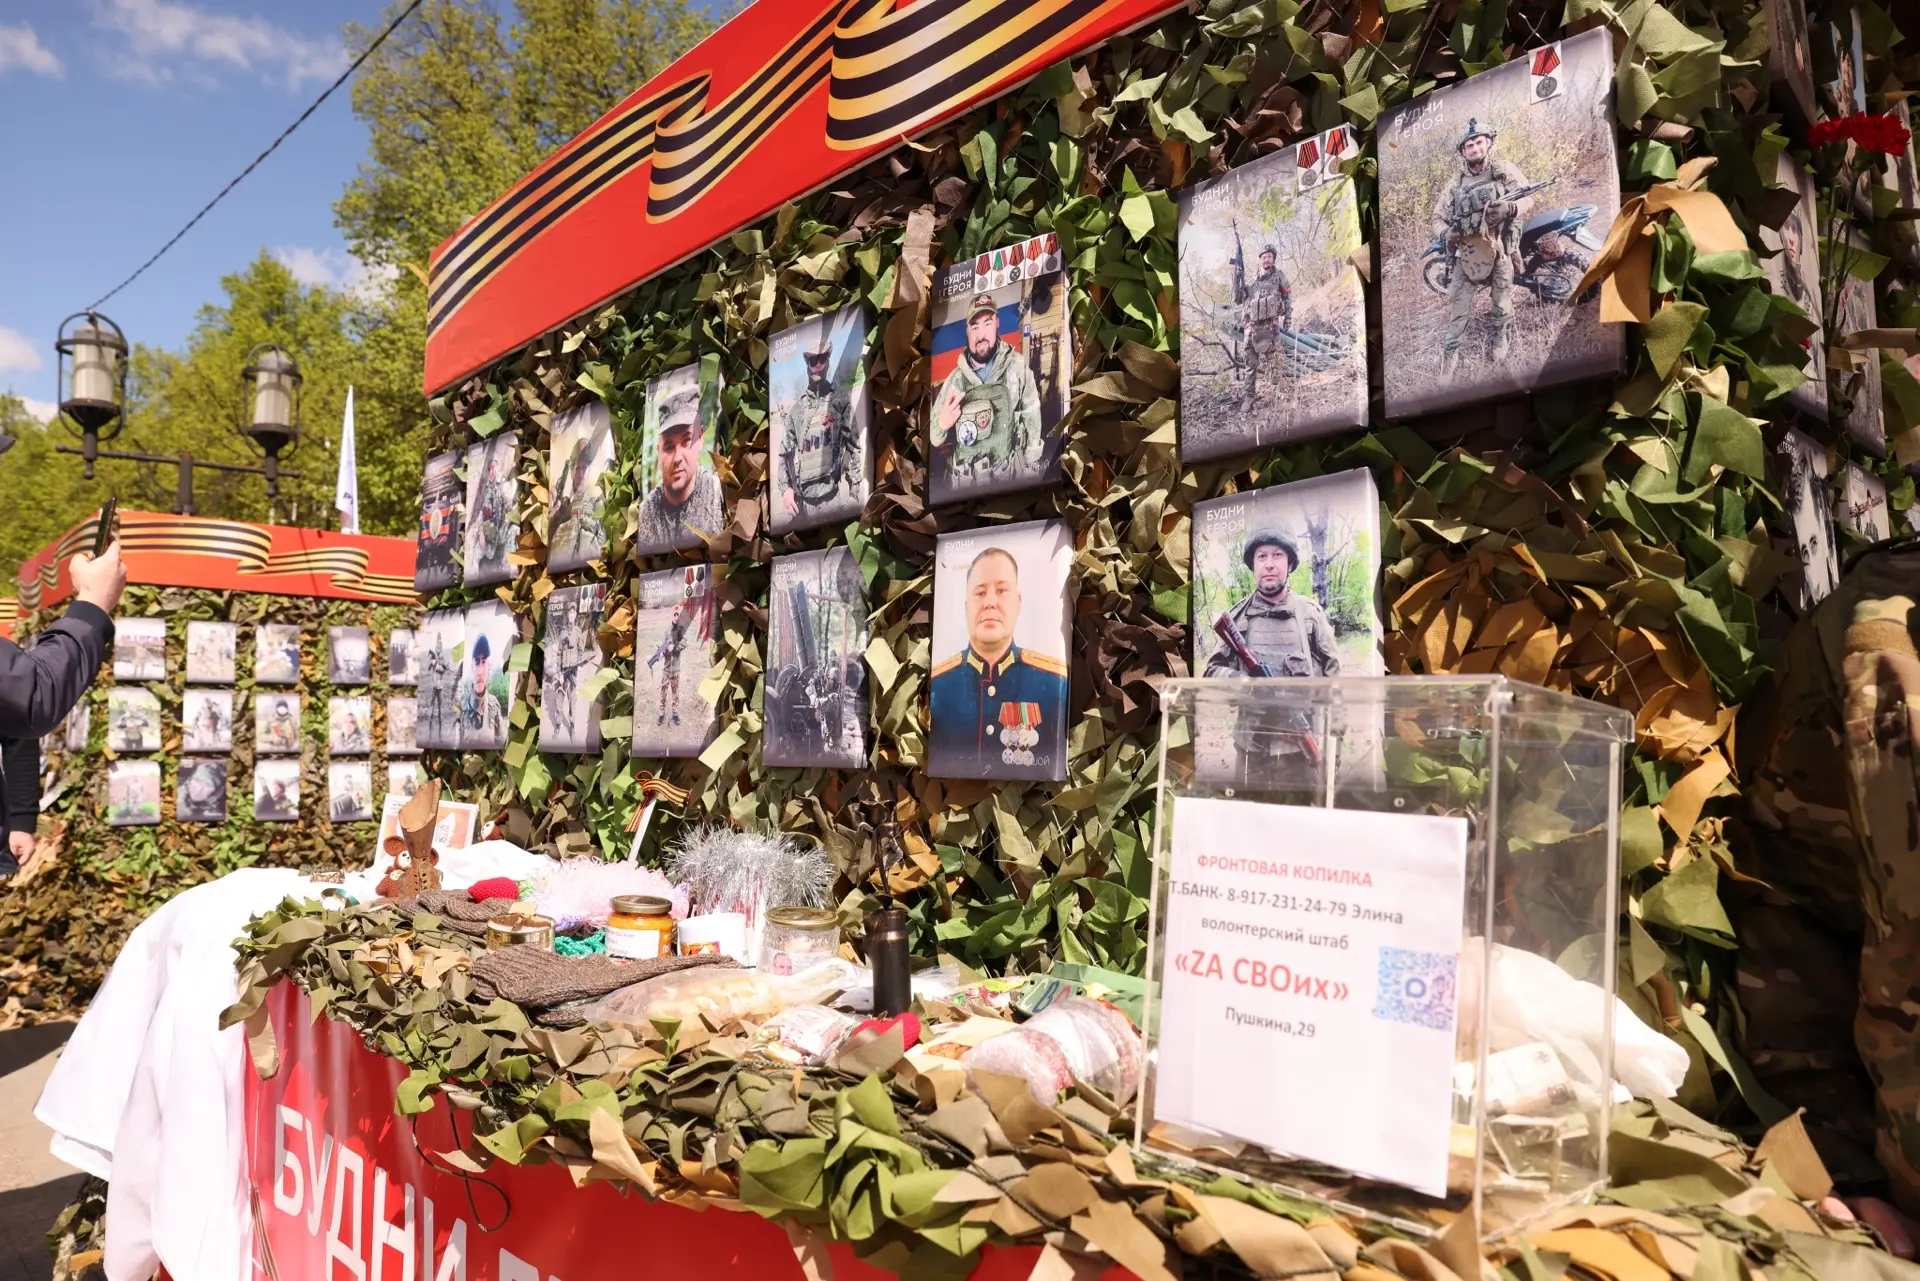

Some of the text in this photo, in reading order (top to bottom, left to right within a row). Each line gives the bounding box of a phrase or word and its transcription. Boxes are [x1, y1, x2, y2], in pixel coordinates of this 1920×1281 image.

[1394, 98, 1443, 127] БУДНИ
[1394, 113, 1444, 141] ГЕРОЯ
[1191, 183, 1229, 206] БУДНИ
[1191, 196, 1230, 217] ГЕРОЯ
[943, 268, 972, 286] БУДНИ
[943, 279, 972, 297] ГЕРОЯ
[775, 332, 797, 349] БУДНИ
[1206, 504, 1245, 521] БУДНИ
[1206, 518, 1245, 535] ГЕРОЯ
[945, 540, 974, 551] БУДНИ
[775, 562, 797, 574] БУДНИ
[644, 579, 663, 589] БУДНИ
[1197, 853, 1373, 888] ФРОНТОВАЯ КОПИЛКА
[1227, 887, 1348, 917] 8-917-231-24-79
[1351, 903, 1404, 925] Элина
[1201, 917, 1350, 950] волонтерский штаб
[1174, 949, 1350, 1002] «ZA СВОих»
[1224, 1006, 1317, 1038] Пушкина,29
[274, 1103, 467, 1281] БУДНИ
